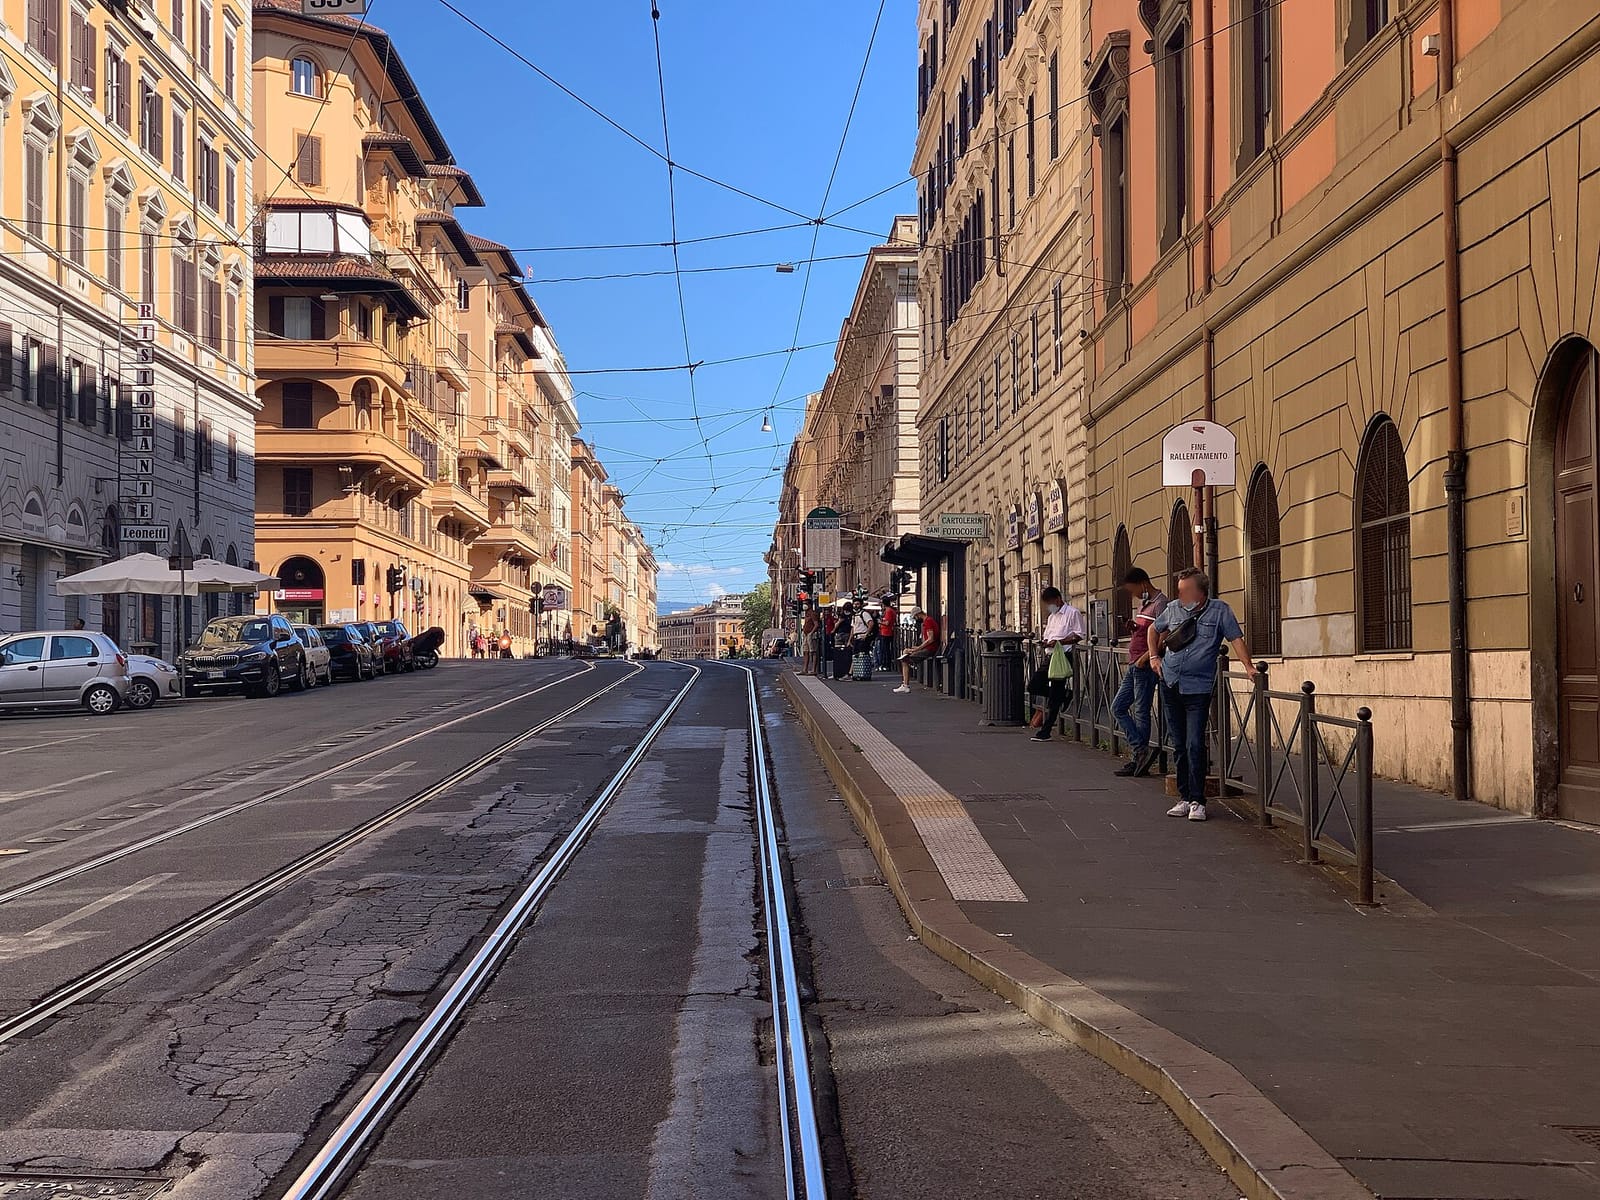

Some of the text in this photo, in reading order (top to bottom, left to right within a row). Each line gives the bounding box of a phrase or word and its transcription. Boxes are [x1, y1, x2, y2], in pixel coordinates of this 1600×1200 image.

[139, 304, 152, 518] RISTORANTE
[1190, 443, 1207, 451] FINE
[1169, 452, 1228, 460] RALLENTAMENTO
[941, 517, 983, 525] CARTOLERIA
[123, 527, 166, 539] Leonetti
[942, 527, 982, 535] FOTOCOPIE
